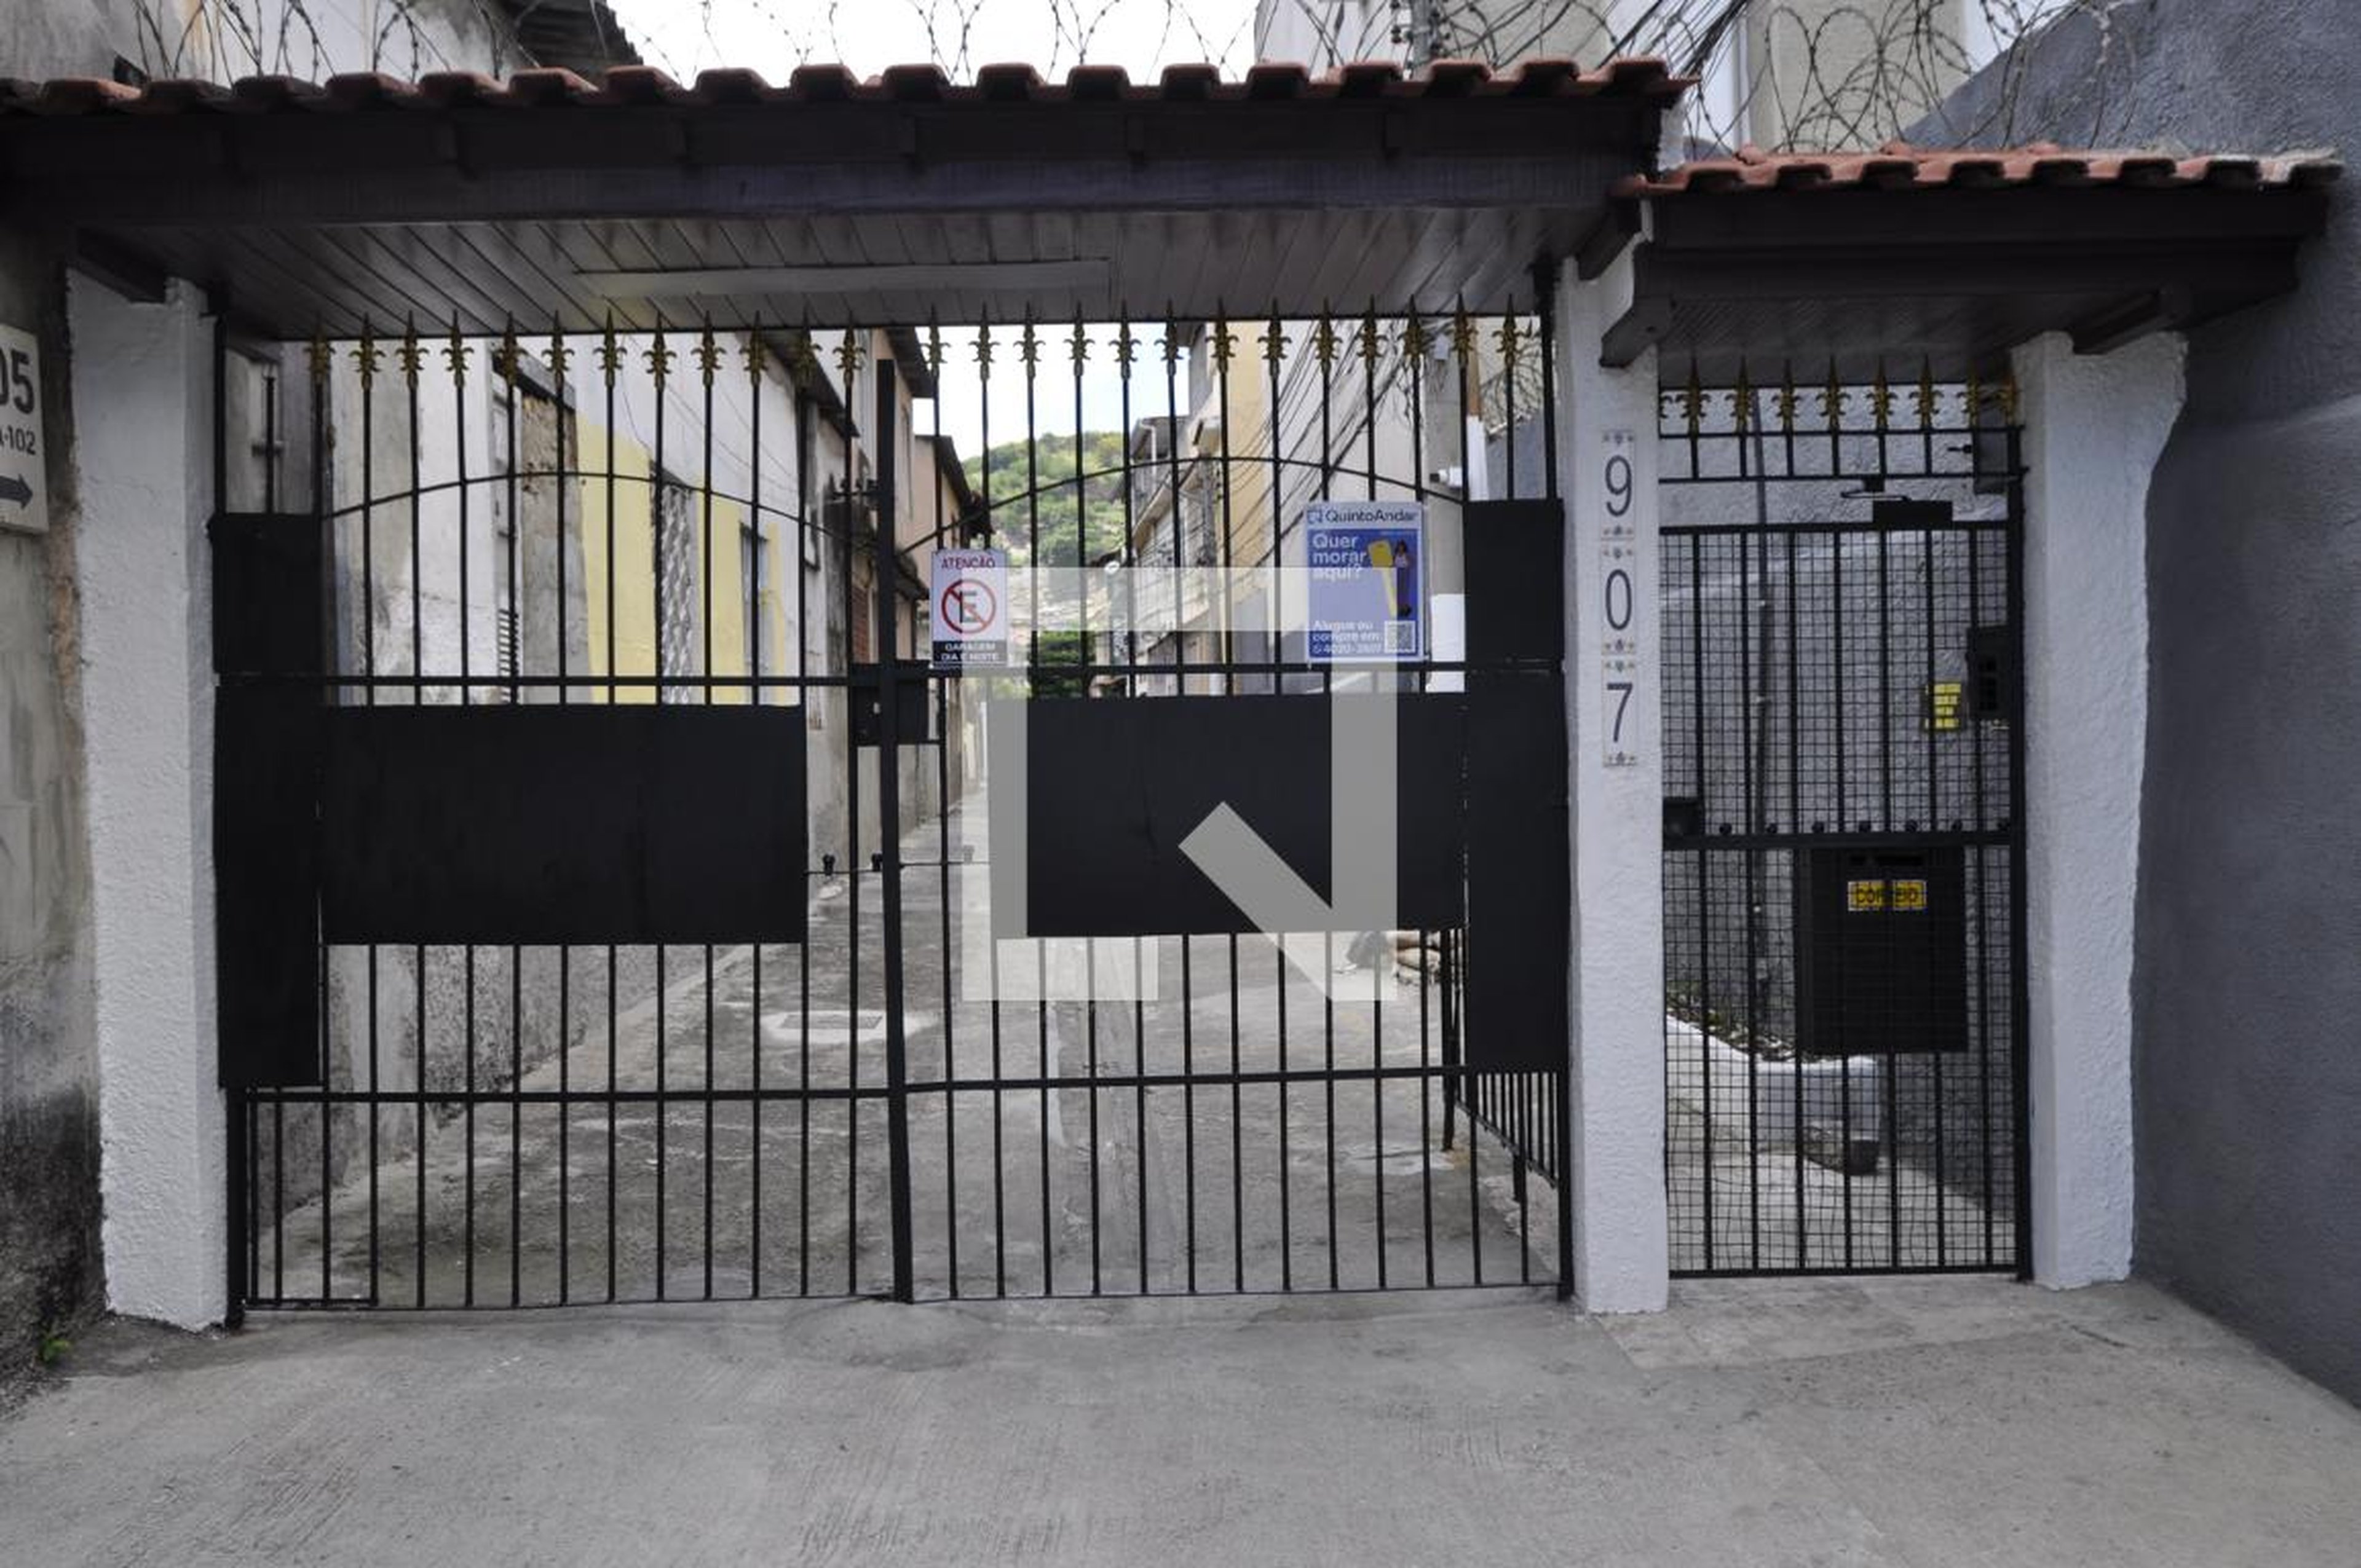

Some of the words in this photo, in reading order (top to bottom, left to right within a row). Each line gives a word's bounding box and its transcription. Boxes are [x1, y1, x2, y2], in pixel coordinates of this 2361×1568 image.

[1313, 533, 1358, 549] Quer
[941, 555, 995, 569] ATENÇÃO
[1313, 551, 1366, 564] morar
[1313, 563, 1362, 582] aqui?
